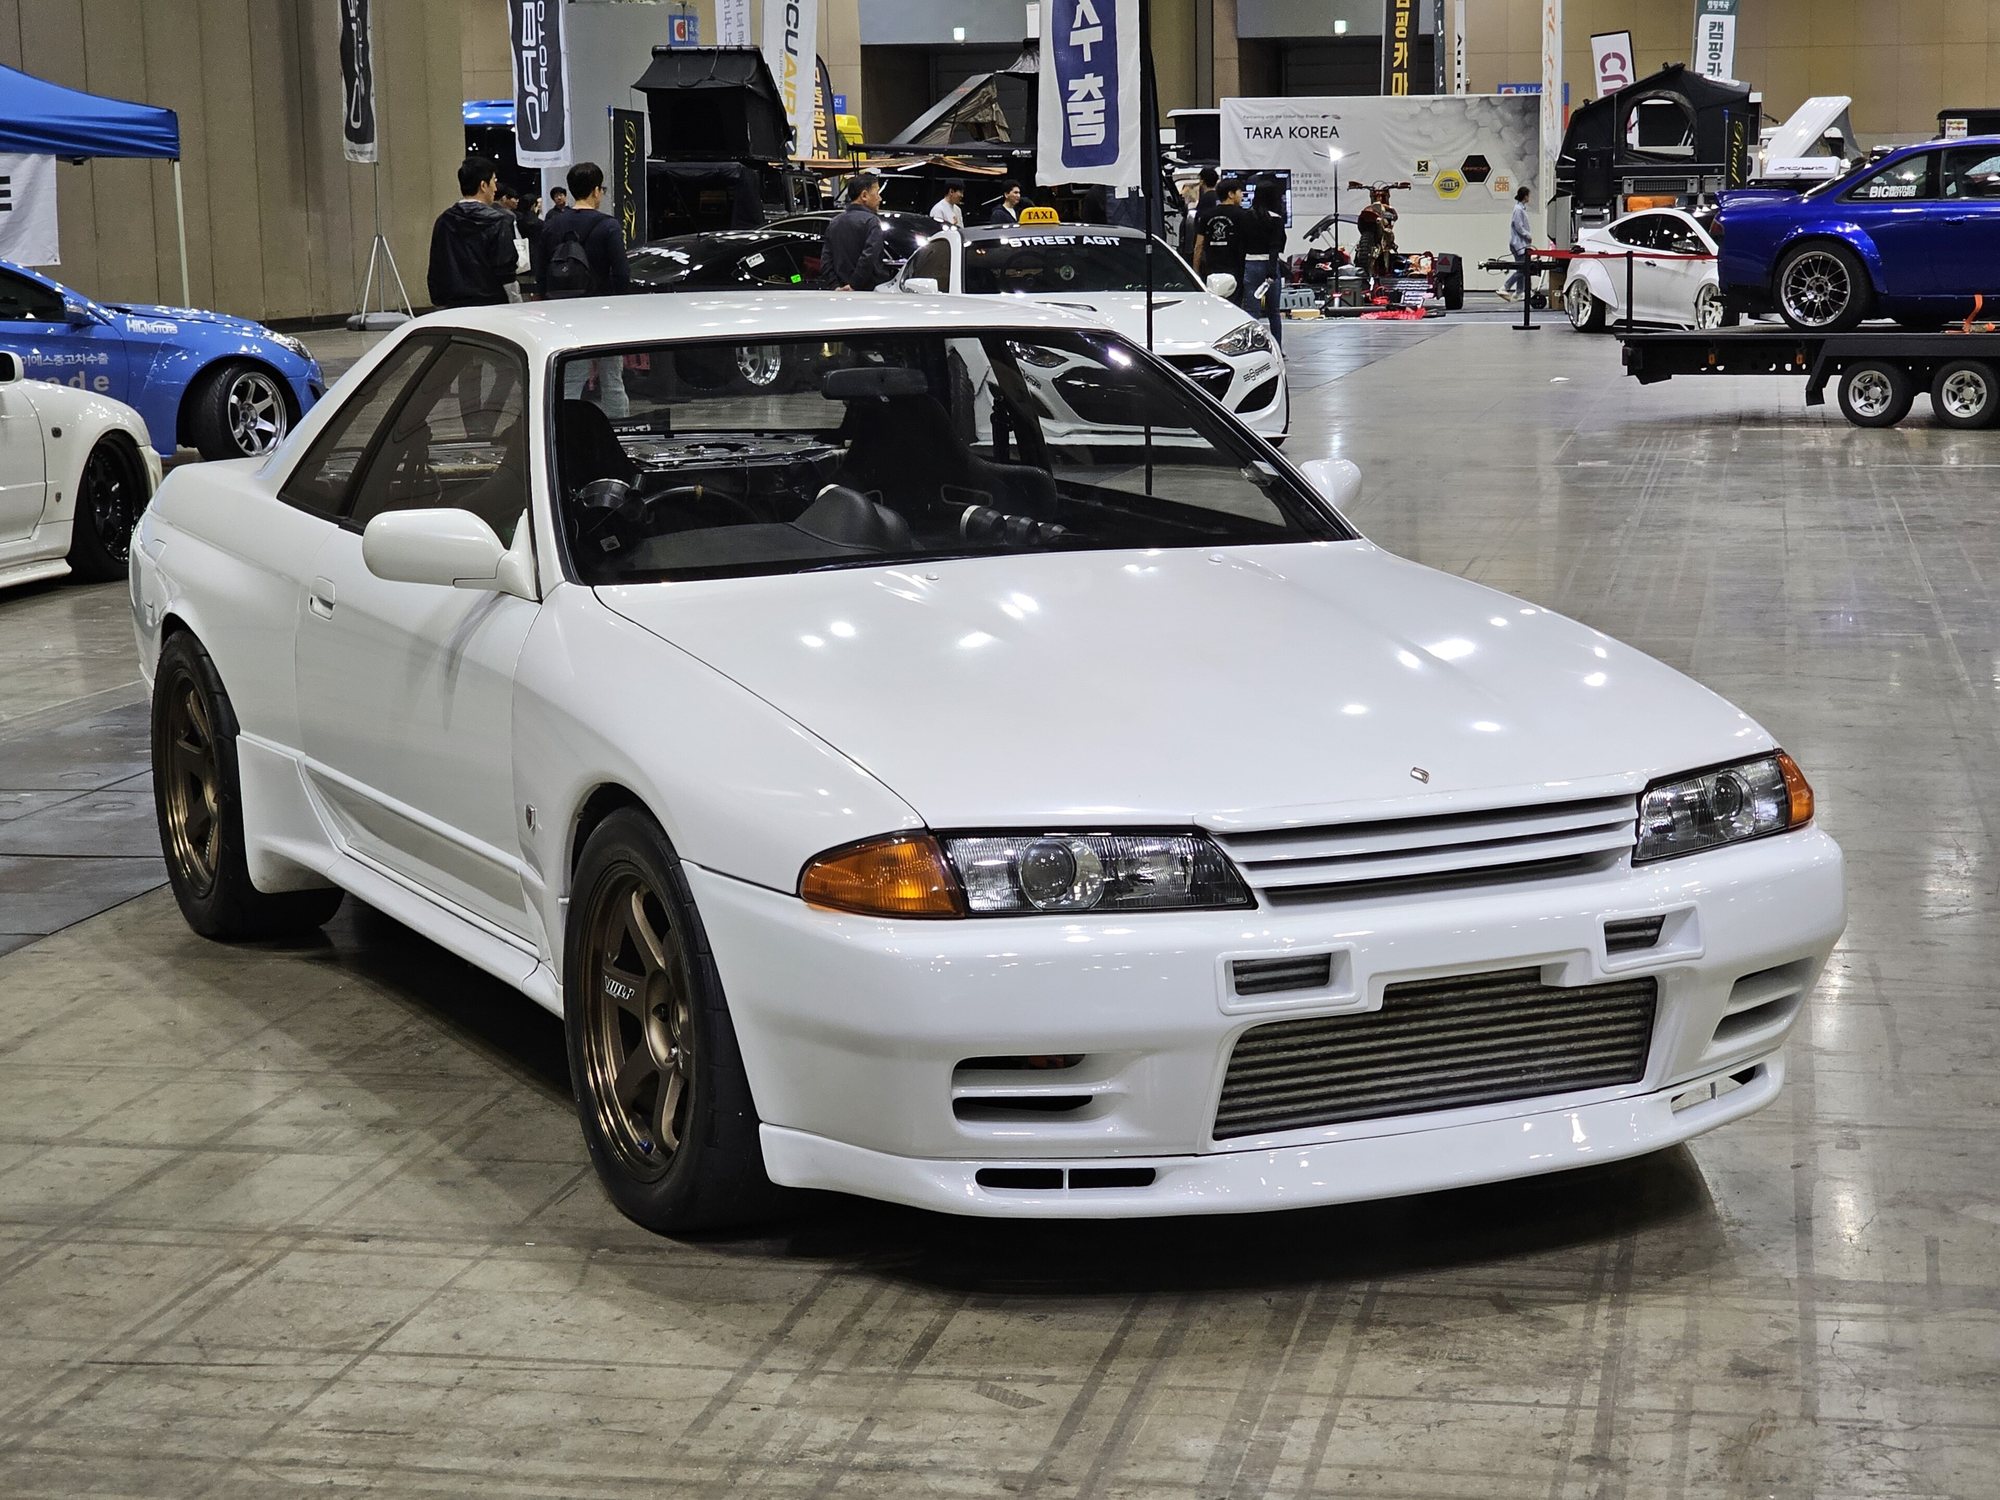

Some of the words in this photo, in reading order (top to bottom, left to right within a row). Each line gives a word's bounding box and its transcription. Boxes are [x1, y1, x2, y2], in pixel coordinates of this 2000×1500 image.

[1243, 126, 1283, 139] TARA
[1289, 126, 1340, 139] KOREA
[1869, 185, 1890, 198] BIG
[1026, 211, 1054, 220] TAXI
[1008, 235, 1076, 248] STREET
[1082, 235, 1120, 246] AGIT
